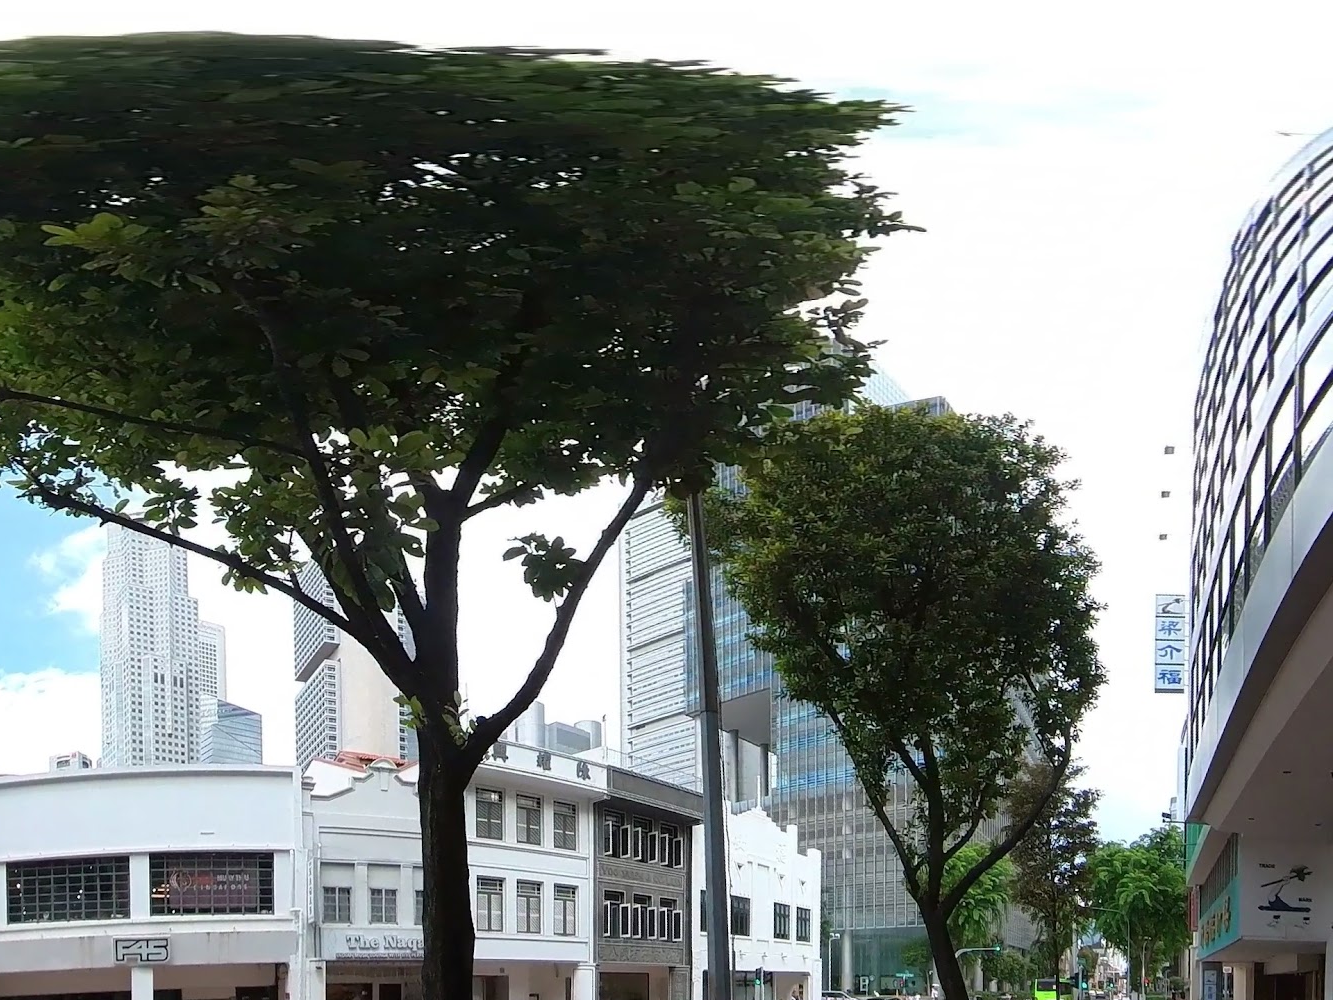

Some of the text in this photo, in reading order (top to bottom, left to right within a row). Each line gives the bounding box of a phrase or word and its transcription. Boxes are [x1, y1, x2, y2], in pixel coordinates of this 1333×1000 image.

[1157, 620, 1183, 685] 梁介福
[115, 938, 169, 962] F45
[346, 935, 380, 950] The
